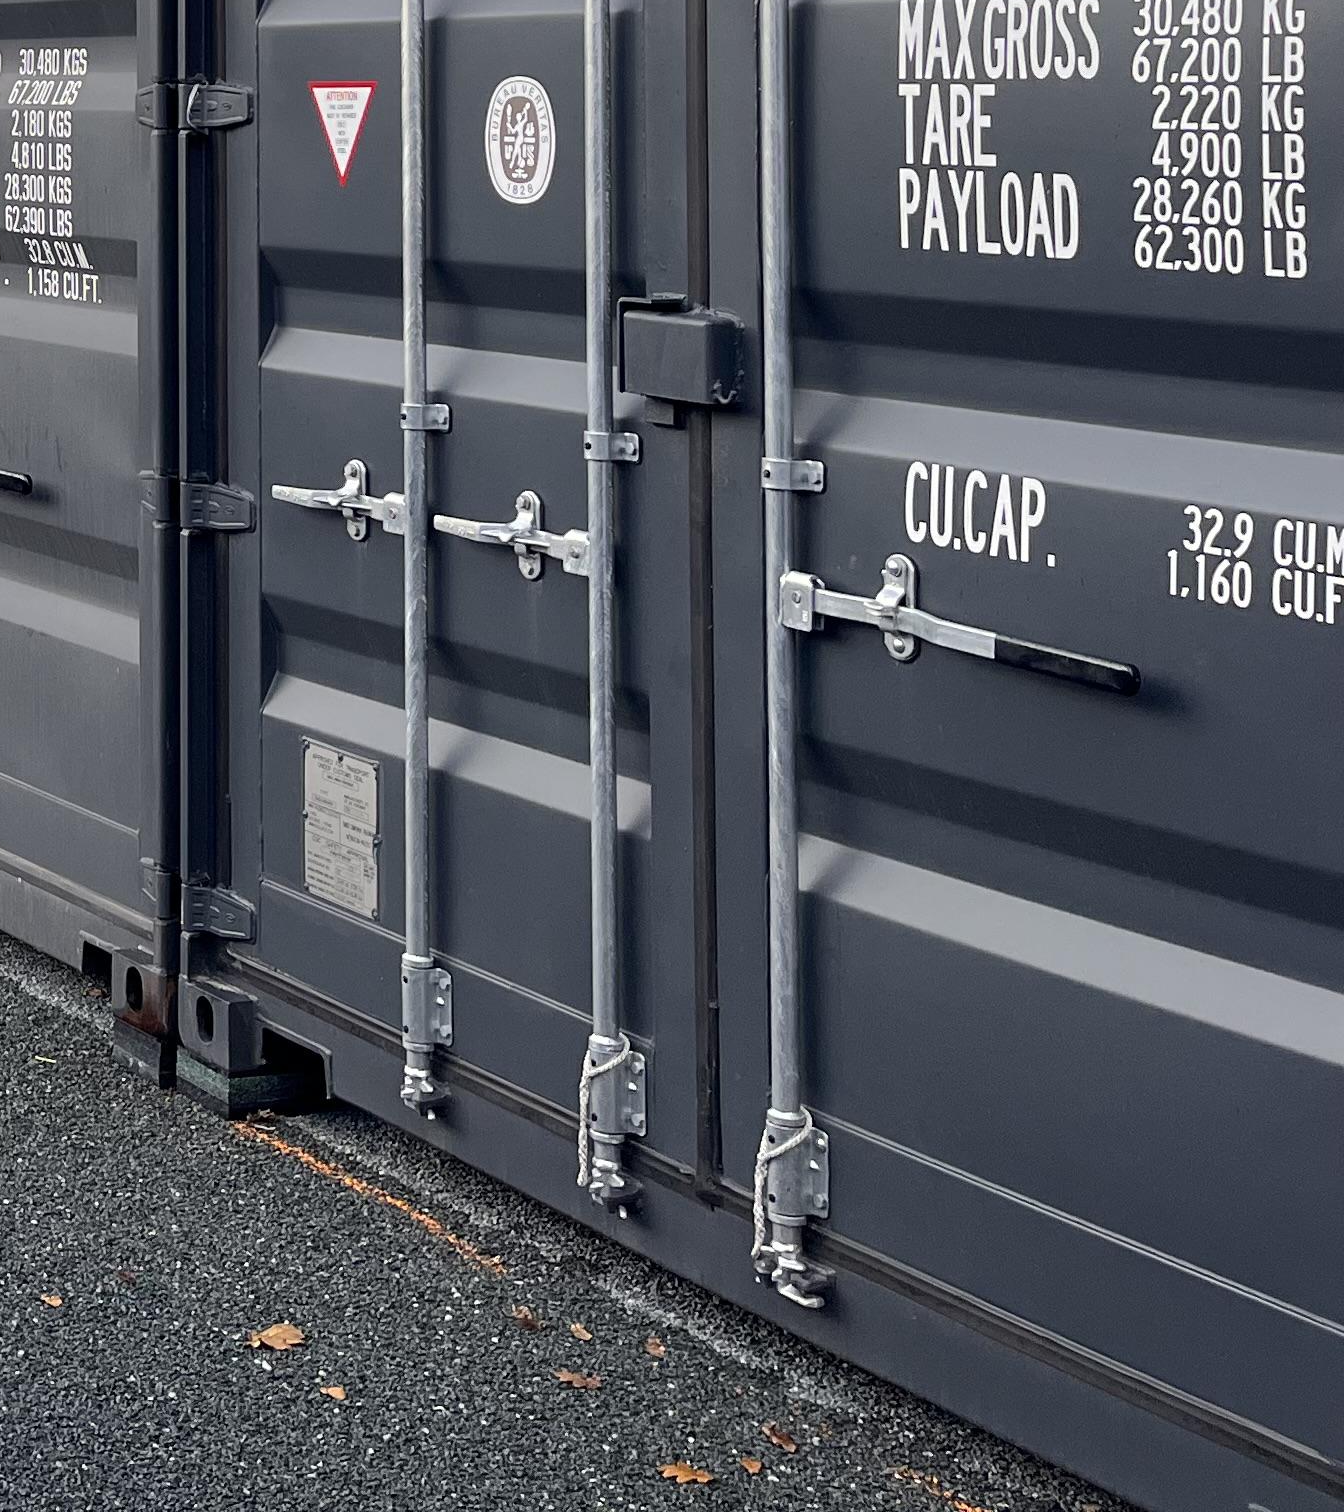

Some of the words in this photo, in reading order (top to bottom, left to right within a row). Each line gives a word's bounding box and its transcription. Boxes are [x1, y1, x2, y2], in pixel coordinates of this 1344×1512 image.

[19, 48, 60, 76] 30,480
[63, 48, 88, 76] KGS
[1131, 37, 1242, 85] 67,200
[1262, 36, 1305, 84] LB
[8, 80, 56, 106] 67,200
[52, 80, 82, 105] LBS
[326, 90, 358, 101] ATTENTION
[11, 110, 45, 138] 2,180
[48, 110, 72, 138] KGS
[492, 84, 517, 142] BUREAU
[522, 84, 548, 144] VERITAS
[898, 83, 997, 167] TARE
[1151, 85, 1242, 132] 2,220
[1261, 85, 1305, 132] KG
[11, 141, 45, 170] 4,810
[48, 142, 72, 171] LBS
[1151, 132, 1242, 180] 4,900
[1262, 132, 1305, 181] LB
[4, 173, 45, 203] 28,300
[48, 176, 72, 205] KGS
[507, 183, 534, 196] 1828
[4, 204, 45, 235] 62,390
[48, 208, 73, 238] LBS
[898, 168, 1080, 260] PAYLOAD
[1132, 177, 1243, 227] 28,260
[1262, 180, 1306, 230] KG
[1133, 225, 1244, 274] 62,300
[1263, 227, 1307, 279] LB
[1182, 504, 1254, 559] 32.9
[1167, 549, 1252, 609] 1,160
